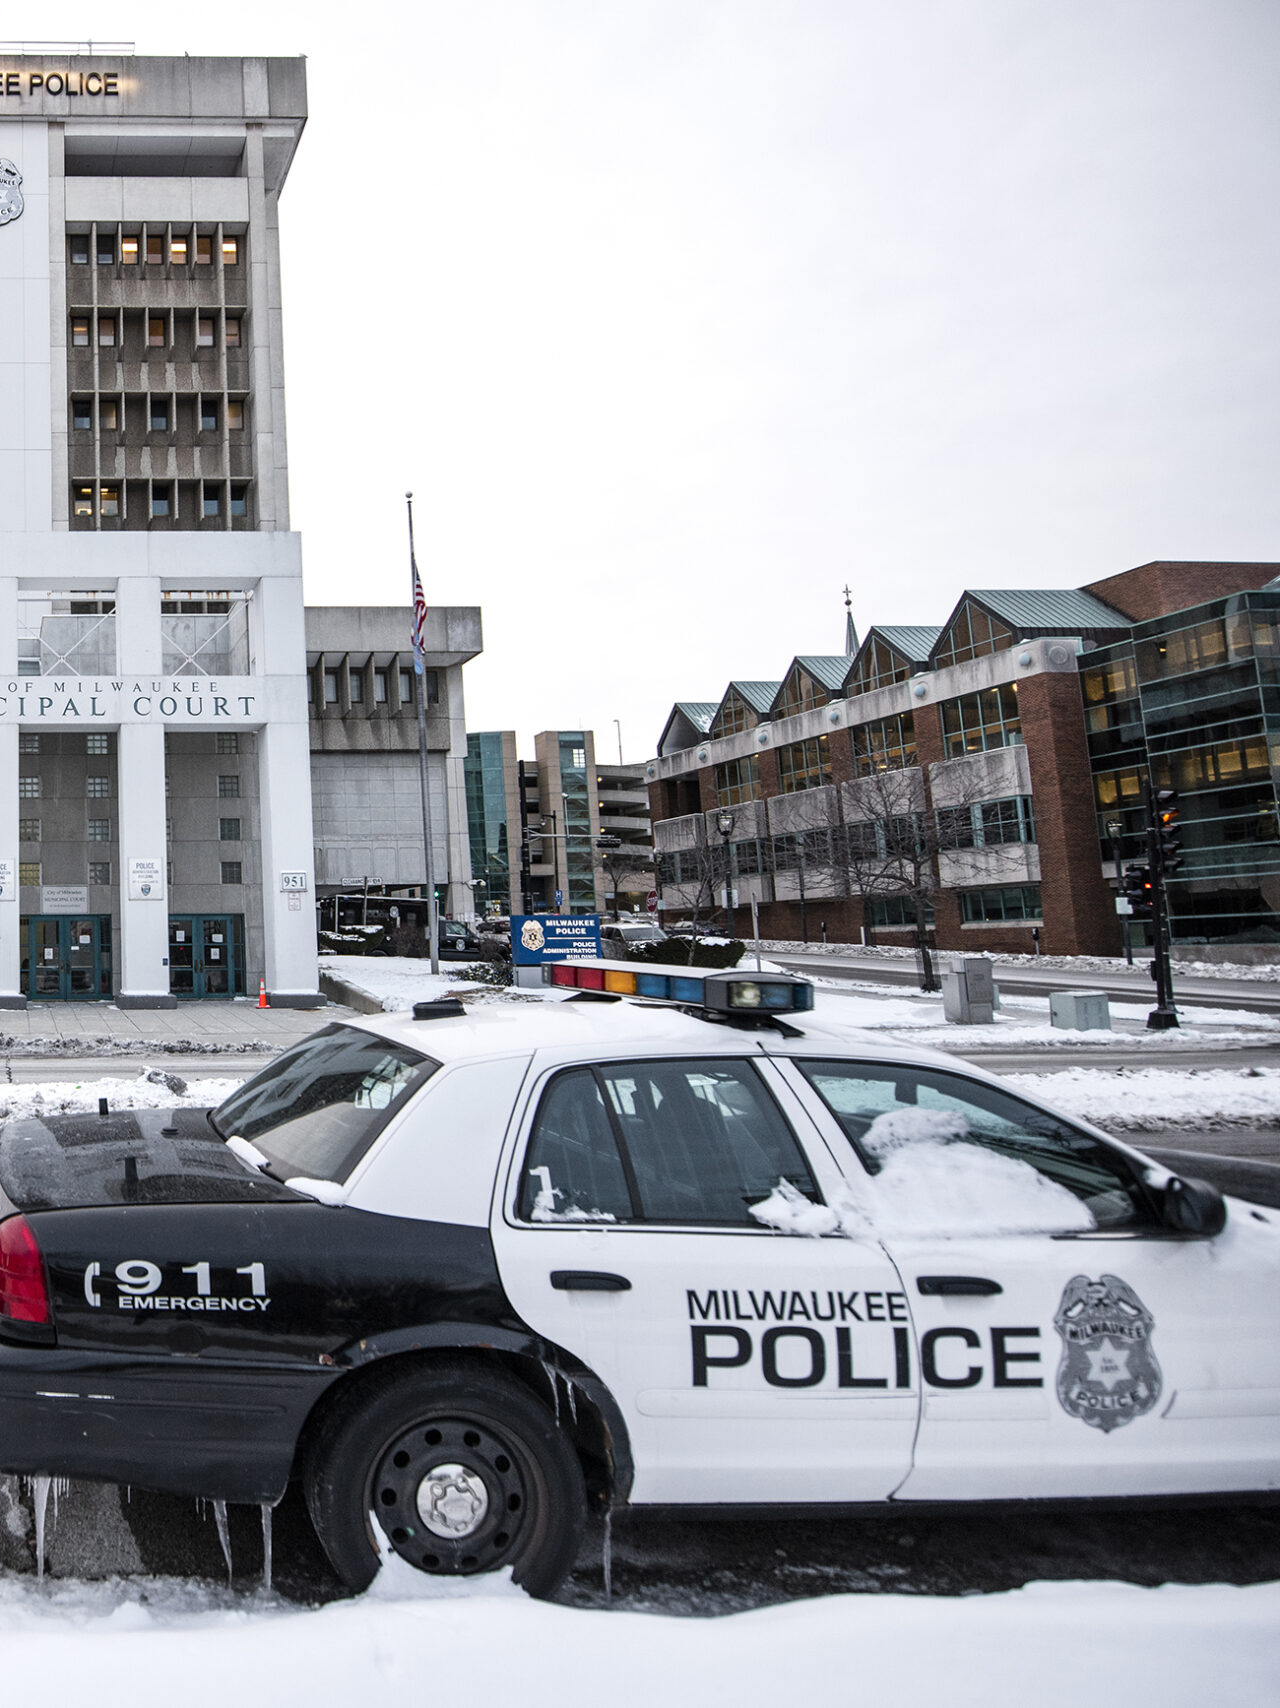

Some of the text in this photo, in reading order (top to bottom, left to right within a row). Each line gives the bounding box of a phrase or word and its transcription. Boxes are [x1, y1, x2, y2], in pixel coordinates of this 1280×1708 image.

[28, 72, 119, 97] POLICE
[7, 682, 33, 694] OF
[54, 682, 220, 693] MILWAUKEE
[133, 696, 256, 717] COURT
[135, 862, 156, 870] POLICE
[283, 875, 304, 888] 951
[646, 896, 658, 906] STOP
[545, 919, 595, 927] MILWAUKEE
[555, 927, 587, 935] POLICE
[114, 1260, 267, 1297] 911
[118, 1296, 272, 1312] EMERGENCY
[687, 1290, 909, 1322] MILWAUKEE
[1070, 1322, 1143, 1339] MILWAUKEE
[690, 1325, 1044, 1389] POLICE
[1076, 1391, 1138, 1409] POLICE
